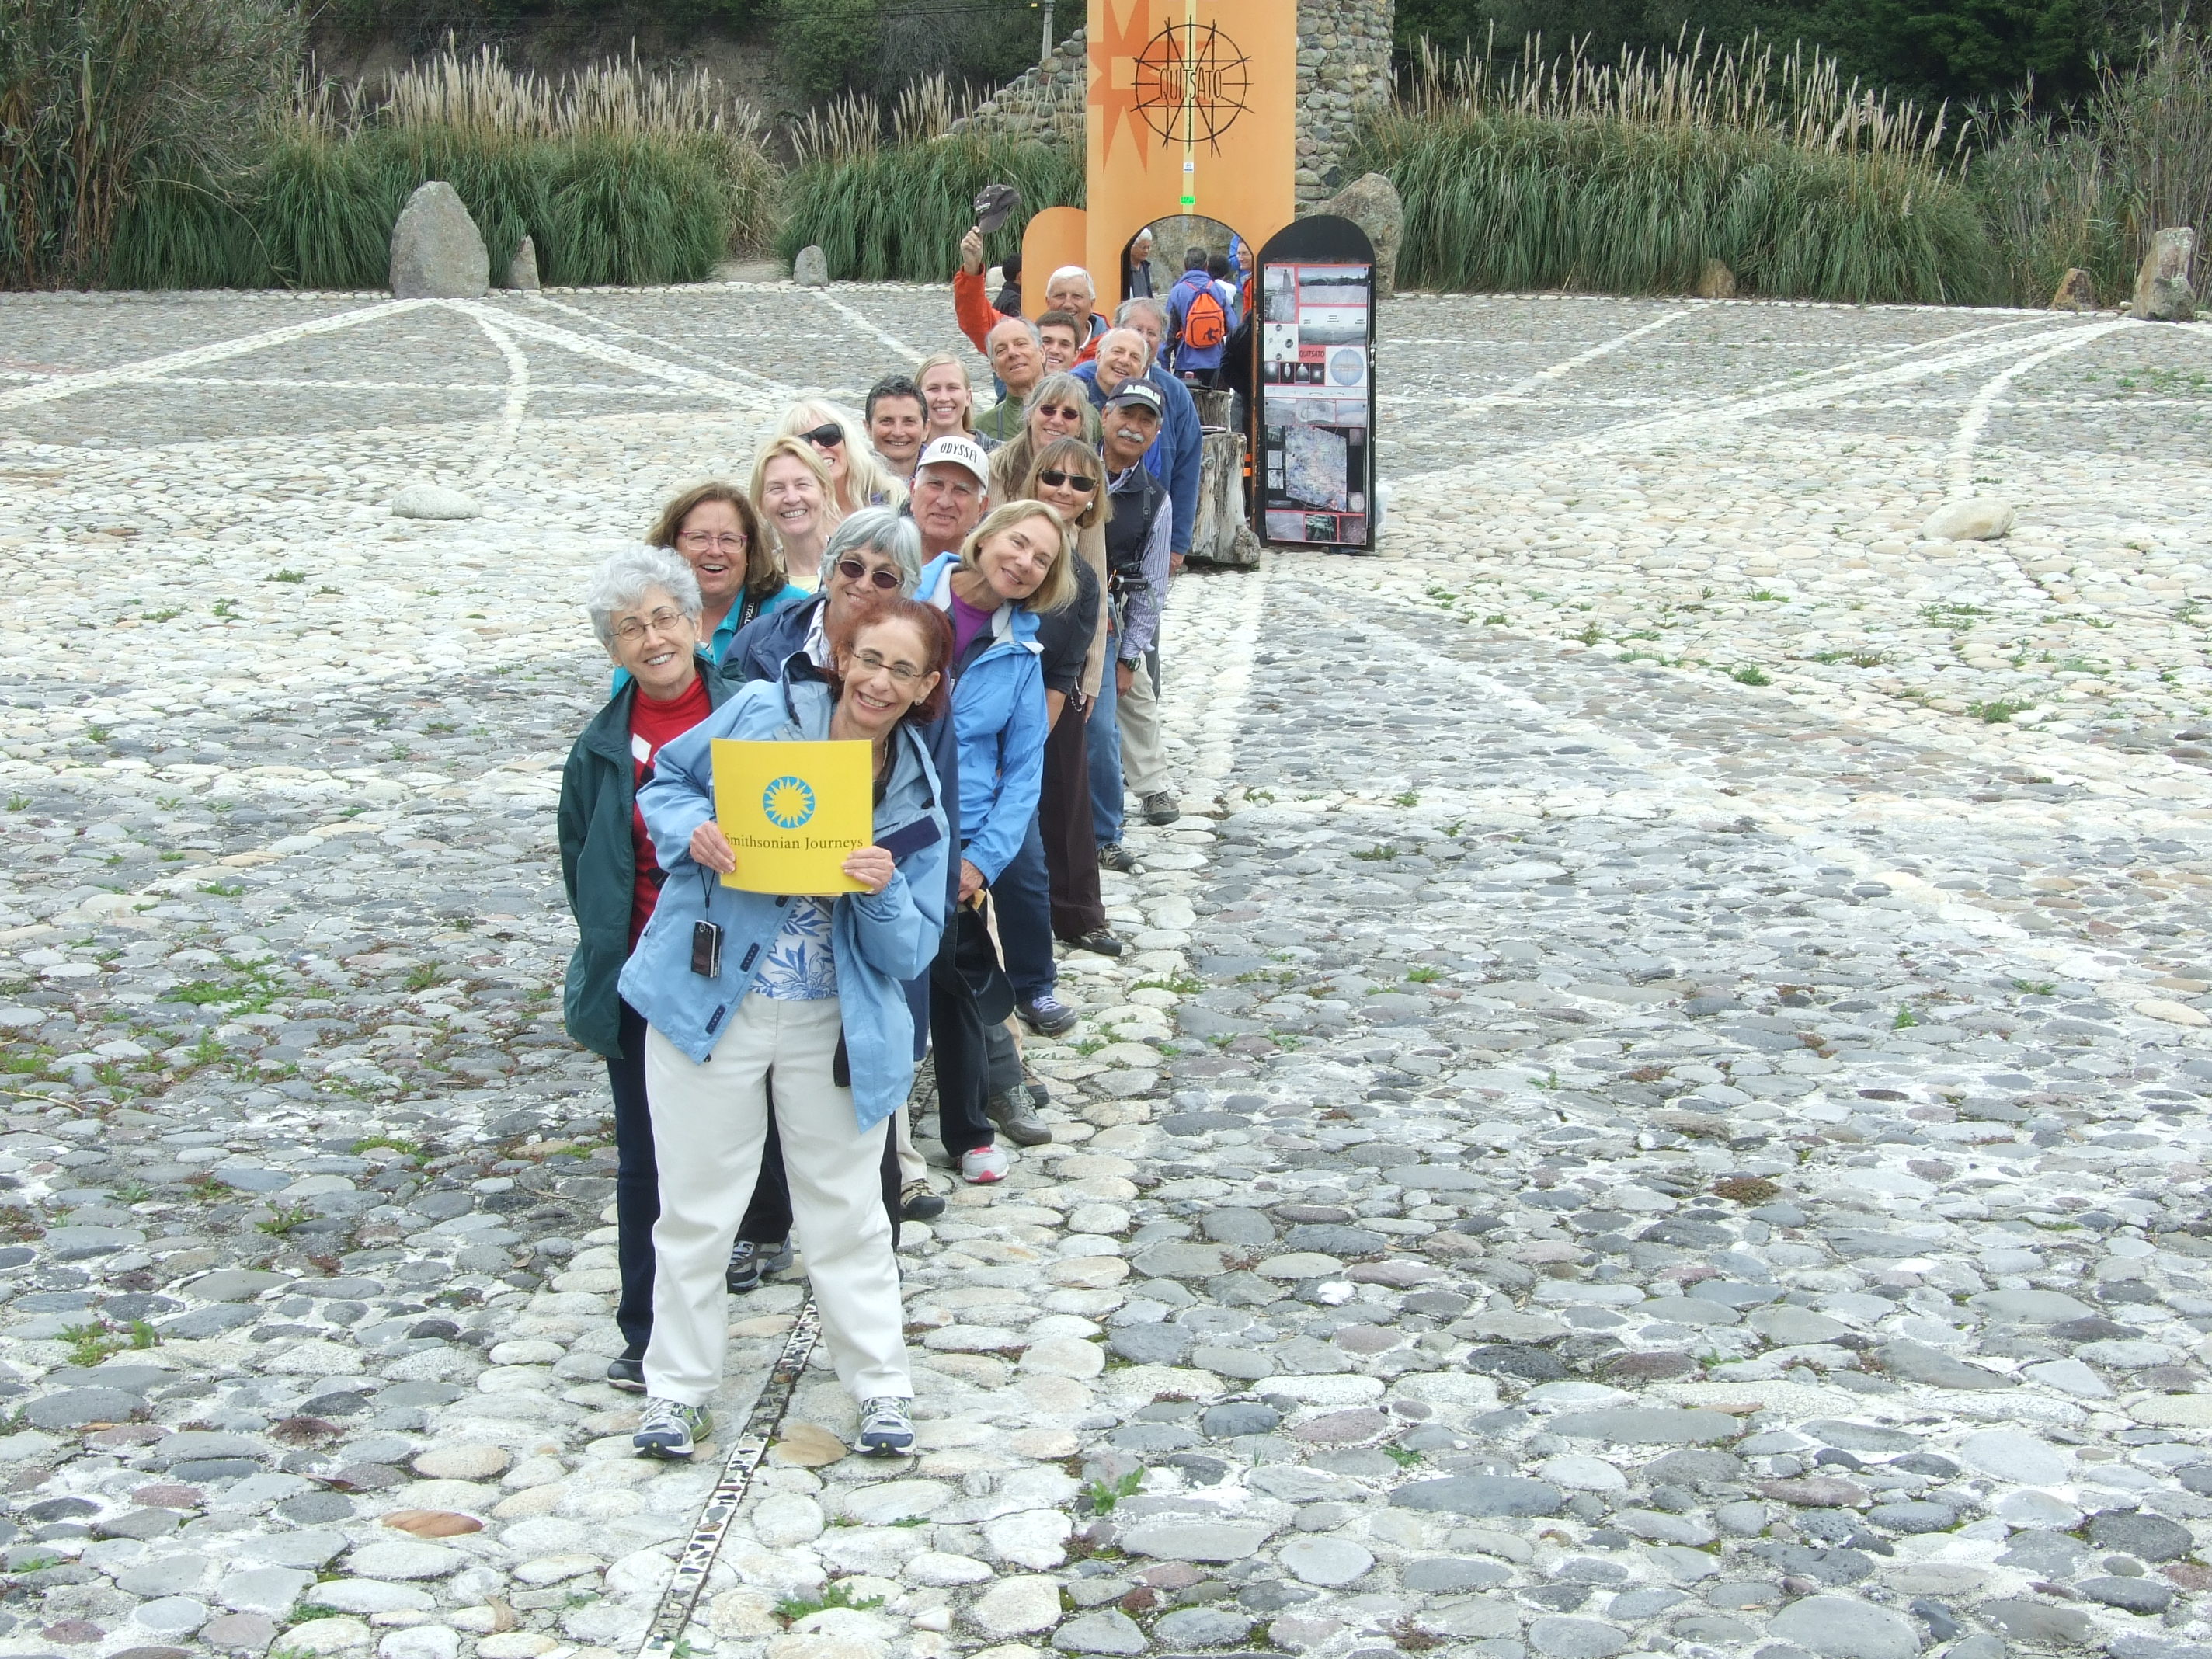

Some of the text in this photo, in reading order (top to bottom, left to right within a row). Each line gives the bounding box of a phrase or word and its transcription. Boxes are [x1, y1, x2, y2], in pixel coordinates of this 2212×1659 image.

[1160, 67, 1222, 106] QUITSATO
[940, 442, 977, 464] ODYSSEY
[744, 603, 754, 624] ITAL
[725, 833, 864, 851] Smithsonian Journeys
